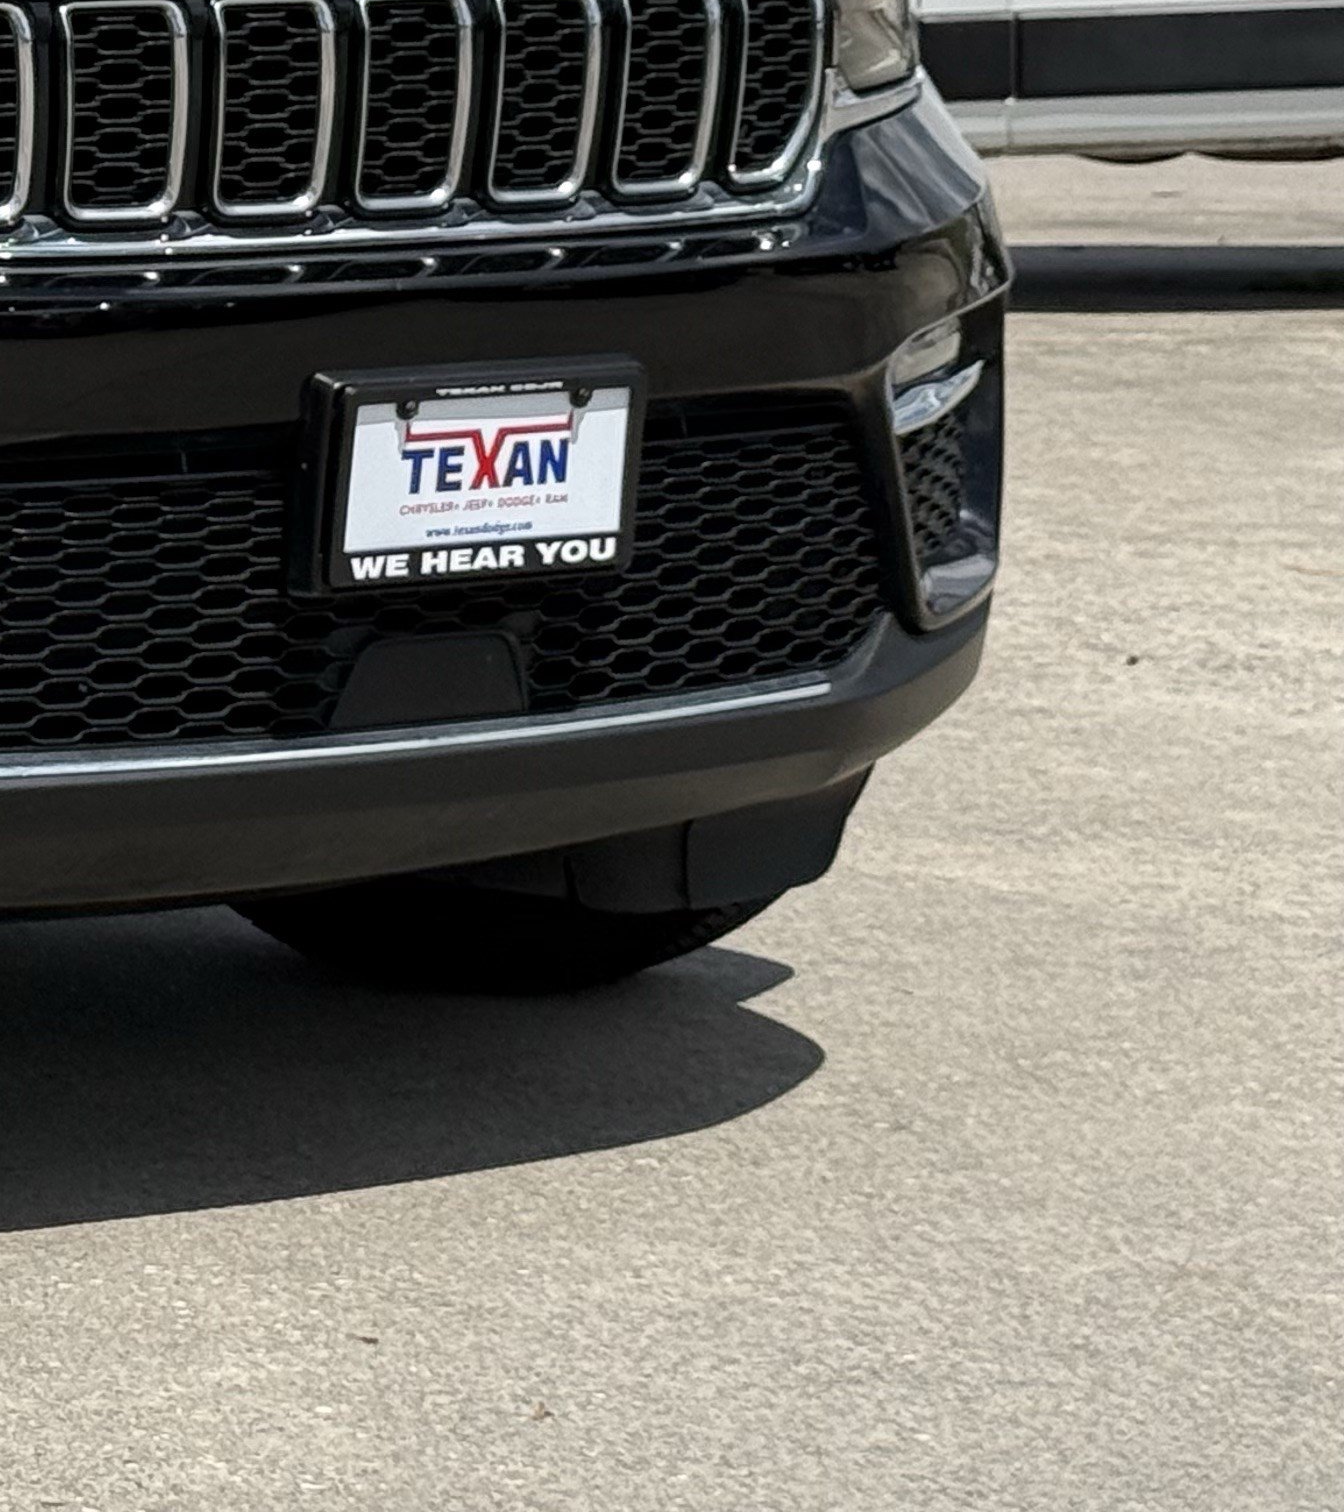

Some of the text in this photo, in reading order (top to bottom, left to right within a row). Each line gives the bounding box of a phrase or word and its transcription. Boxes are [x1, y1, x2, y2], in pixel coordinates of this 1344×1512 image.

[402, 425, 571, 494] TEXAN
[350, 537, 617, 580] WE HEAR YOU
